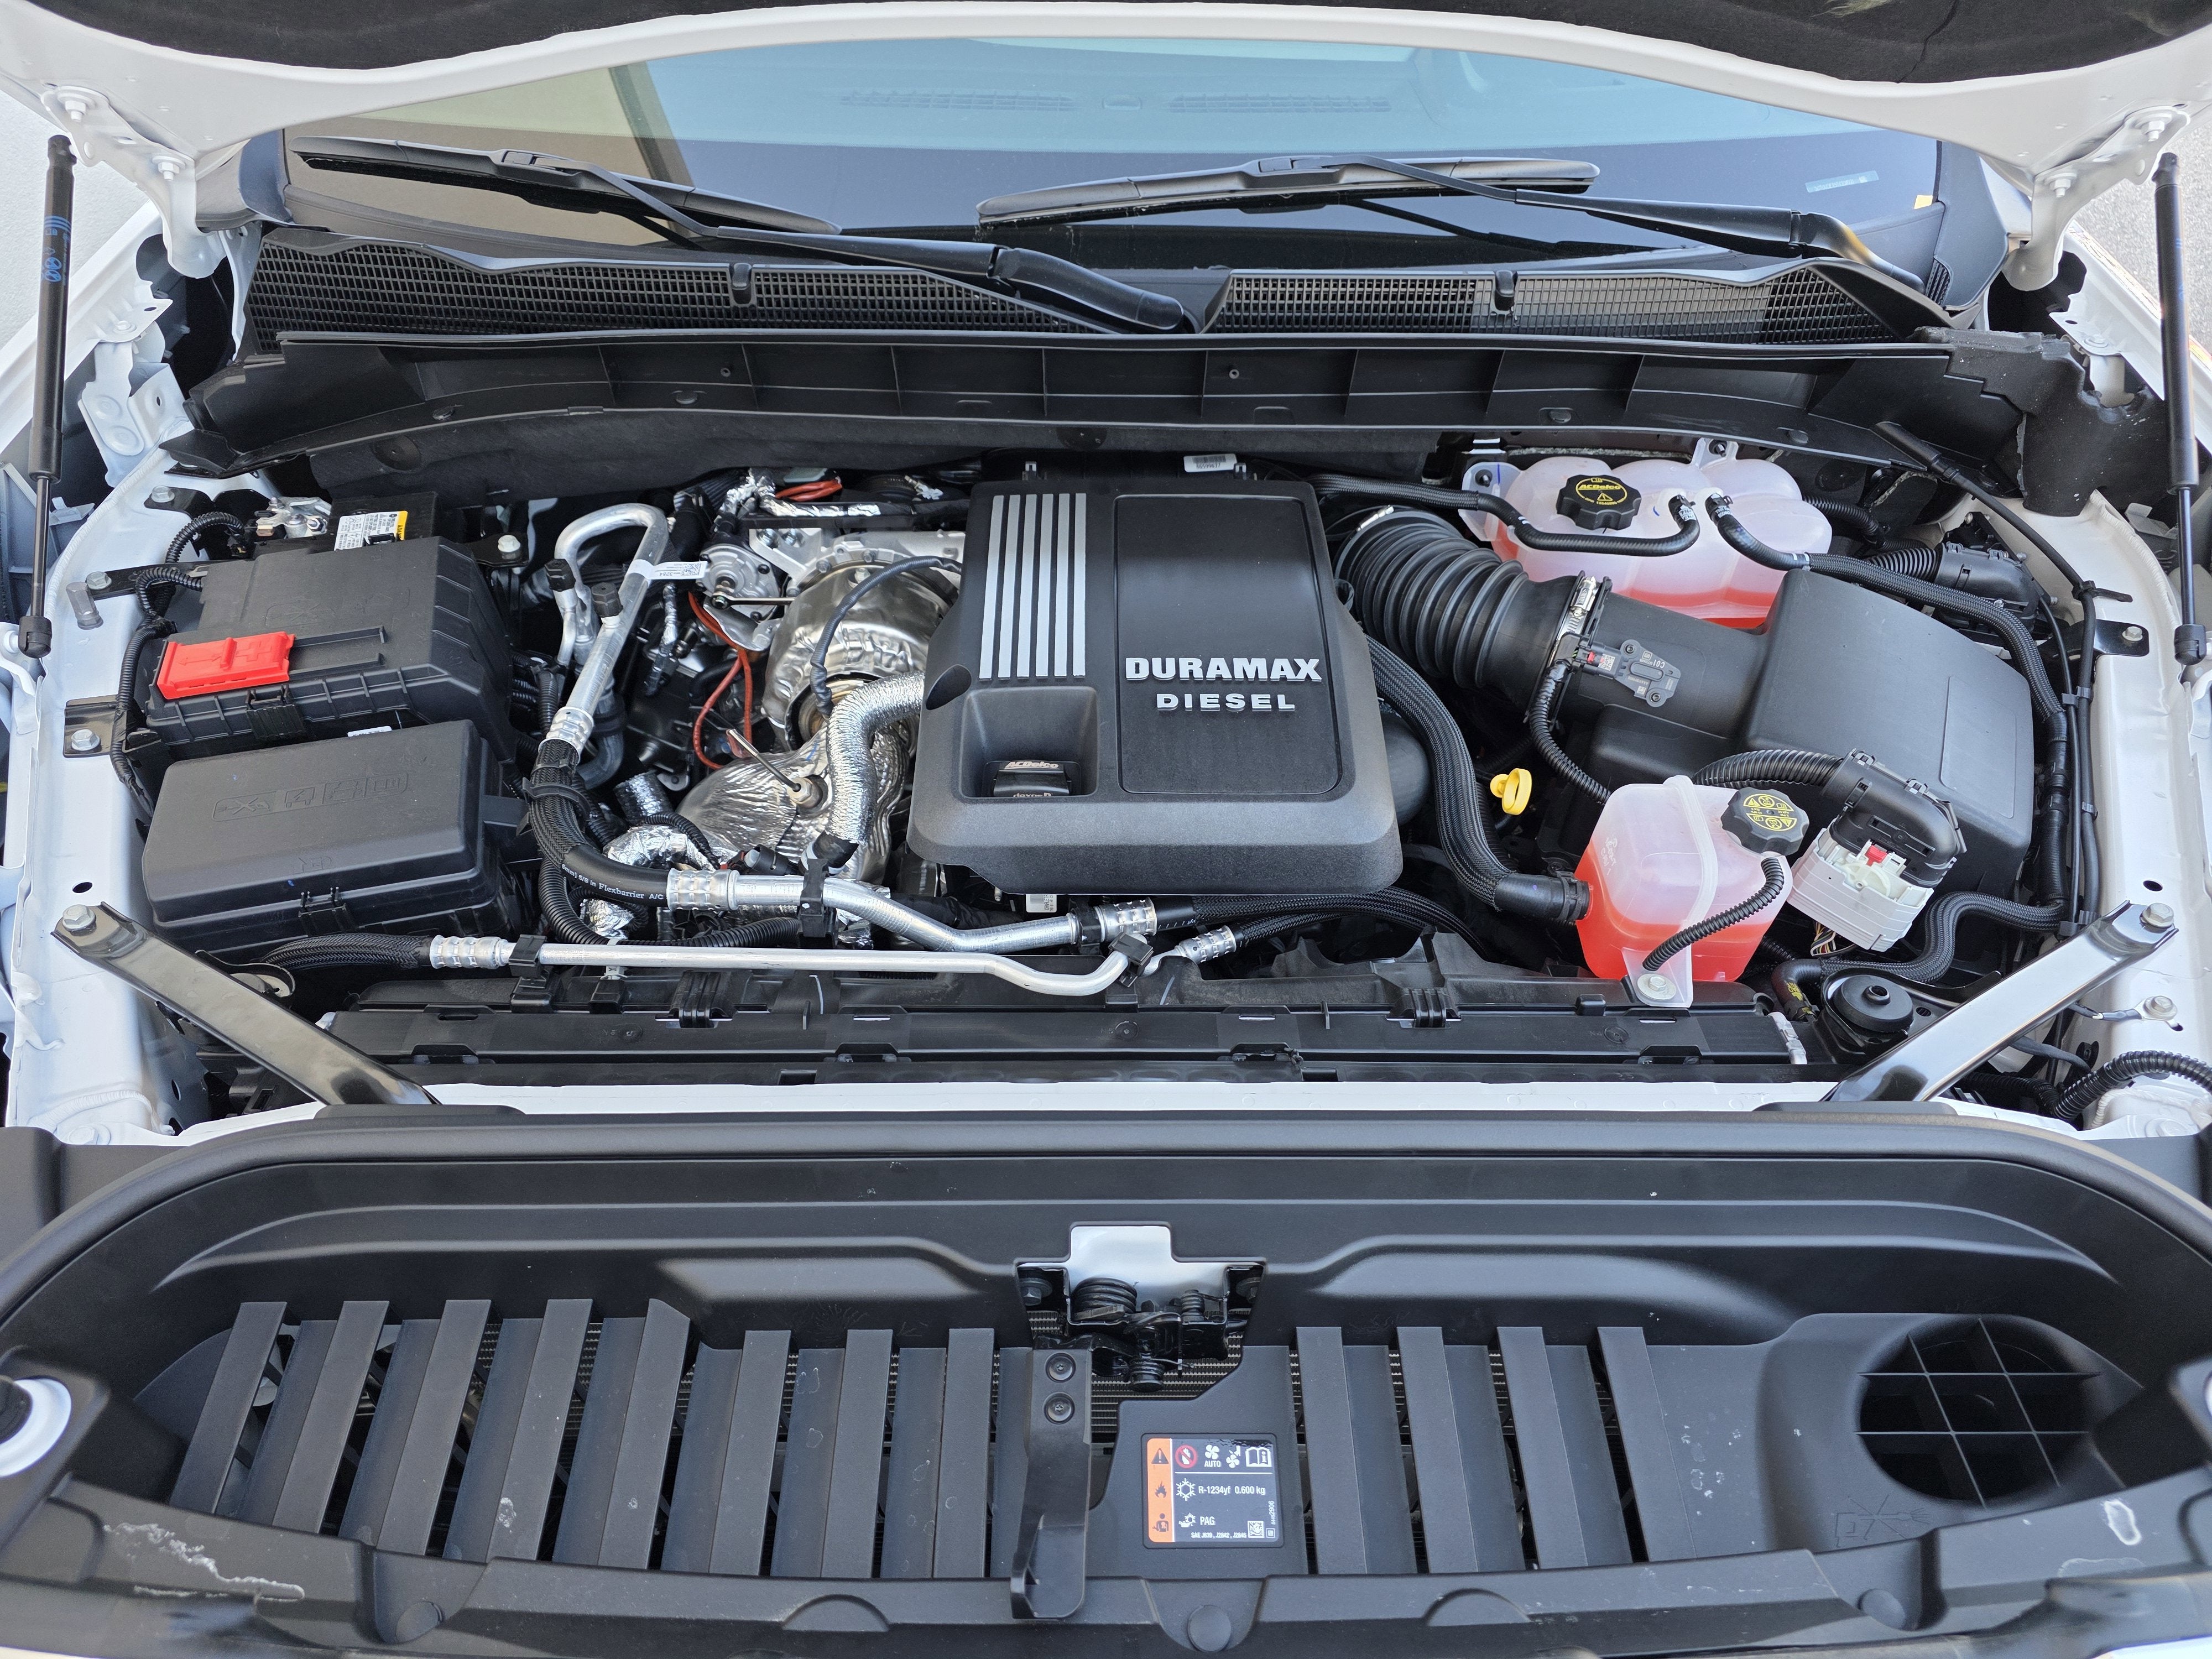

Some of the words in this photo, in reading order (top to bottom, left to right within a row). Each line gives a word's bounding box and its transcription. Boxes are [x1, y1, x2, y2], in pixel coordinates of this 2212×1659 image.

[1125, 658, 1322, 682] DURAMAX
[1156, 693, 1295, 711] DIESEL
[578, 874, 588, 884] 5/8
[598, 882, 645, 899] Flexbarrier
[1198, 1485, 1231, 1496] R-1234yf
[1234, 1486, 1255, 1494] 0.600
[1256, 1486, 1266, 1496] kg
[1199, 1516, 1215, 1526] PAG
